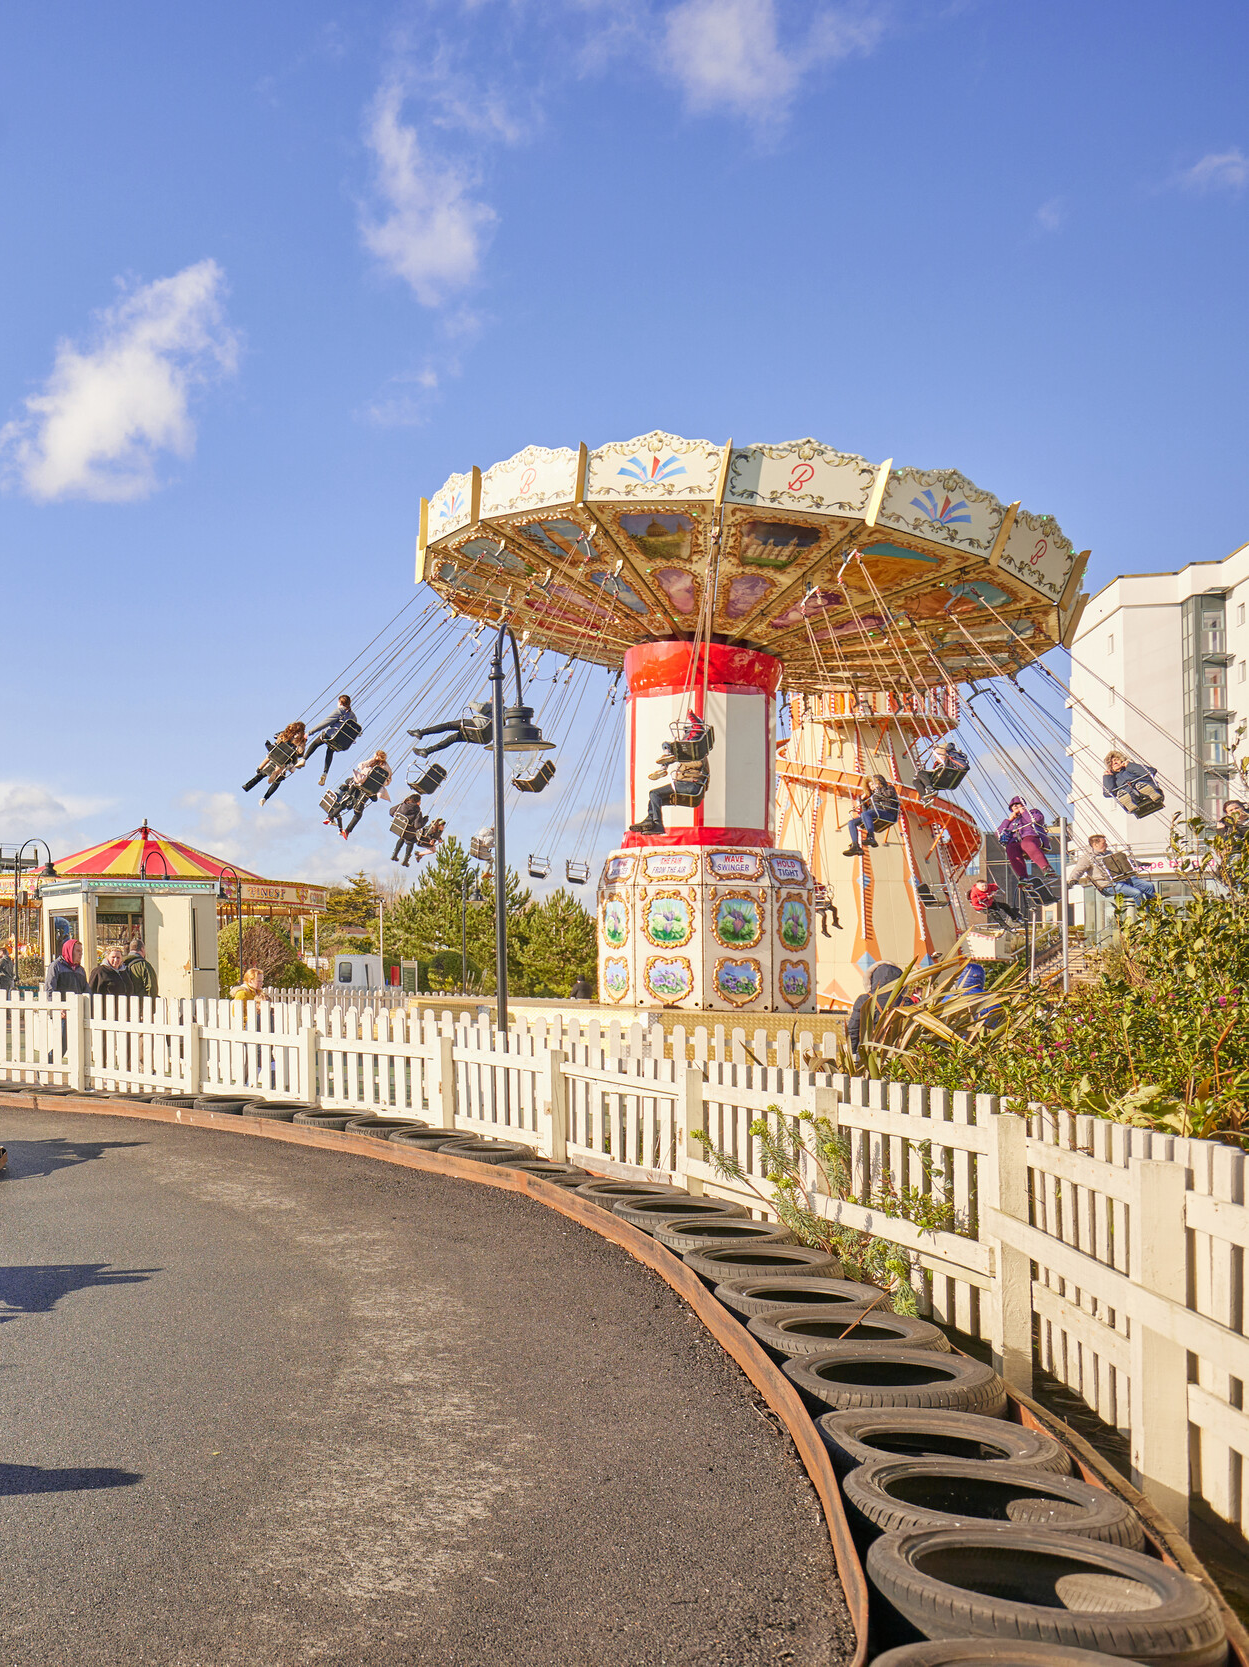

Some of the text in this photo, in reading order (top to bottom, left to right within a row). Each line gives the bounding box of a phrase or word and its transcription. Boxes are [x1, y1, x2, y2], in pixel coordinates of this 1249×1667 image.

[788, 463, 814, 491] B
[717, 863, 749, 871] SWINGER
[776, 860, 795, 868] HOLD
[778, 868, 799, 877] TIGHT
[248, 886, 285, 900] FINEST
